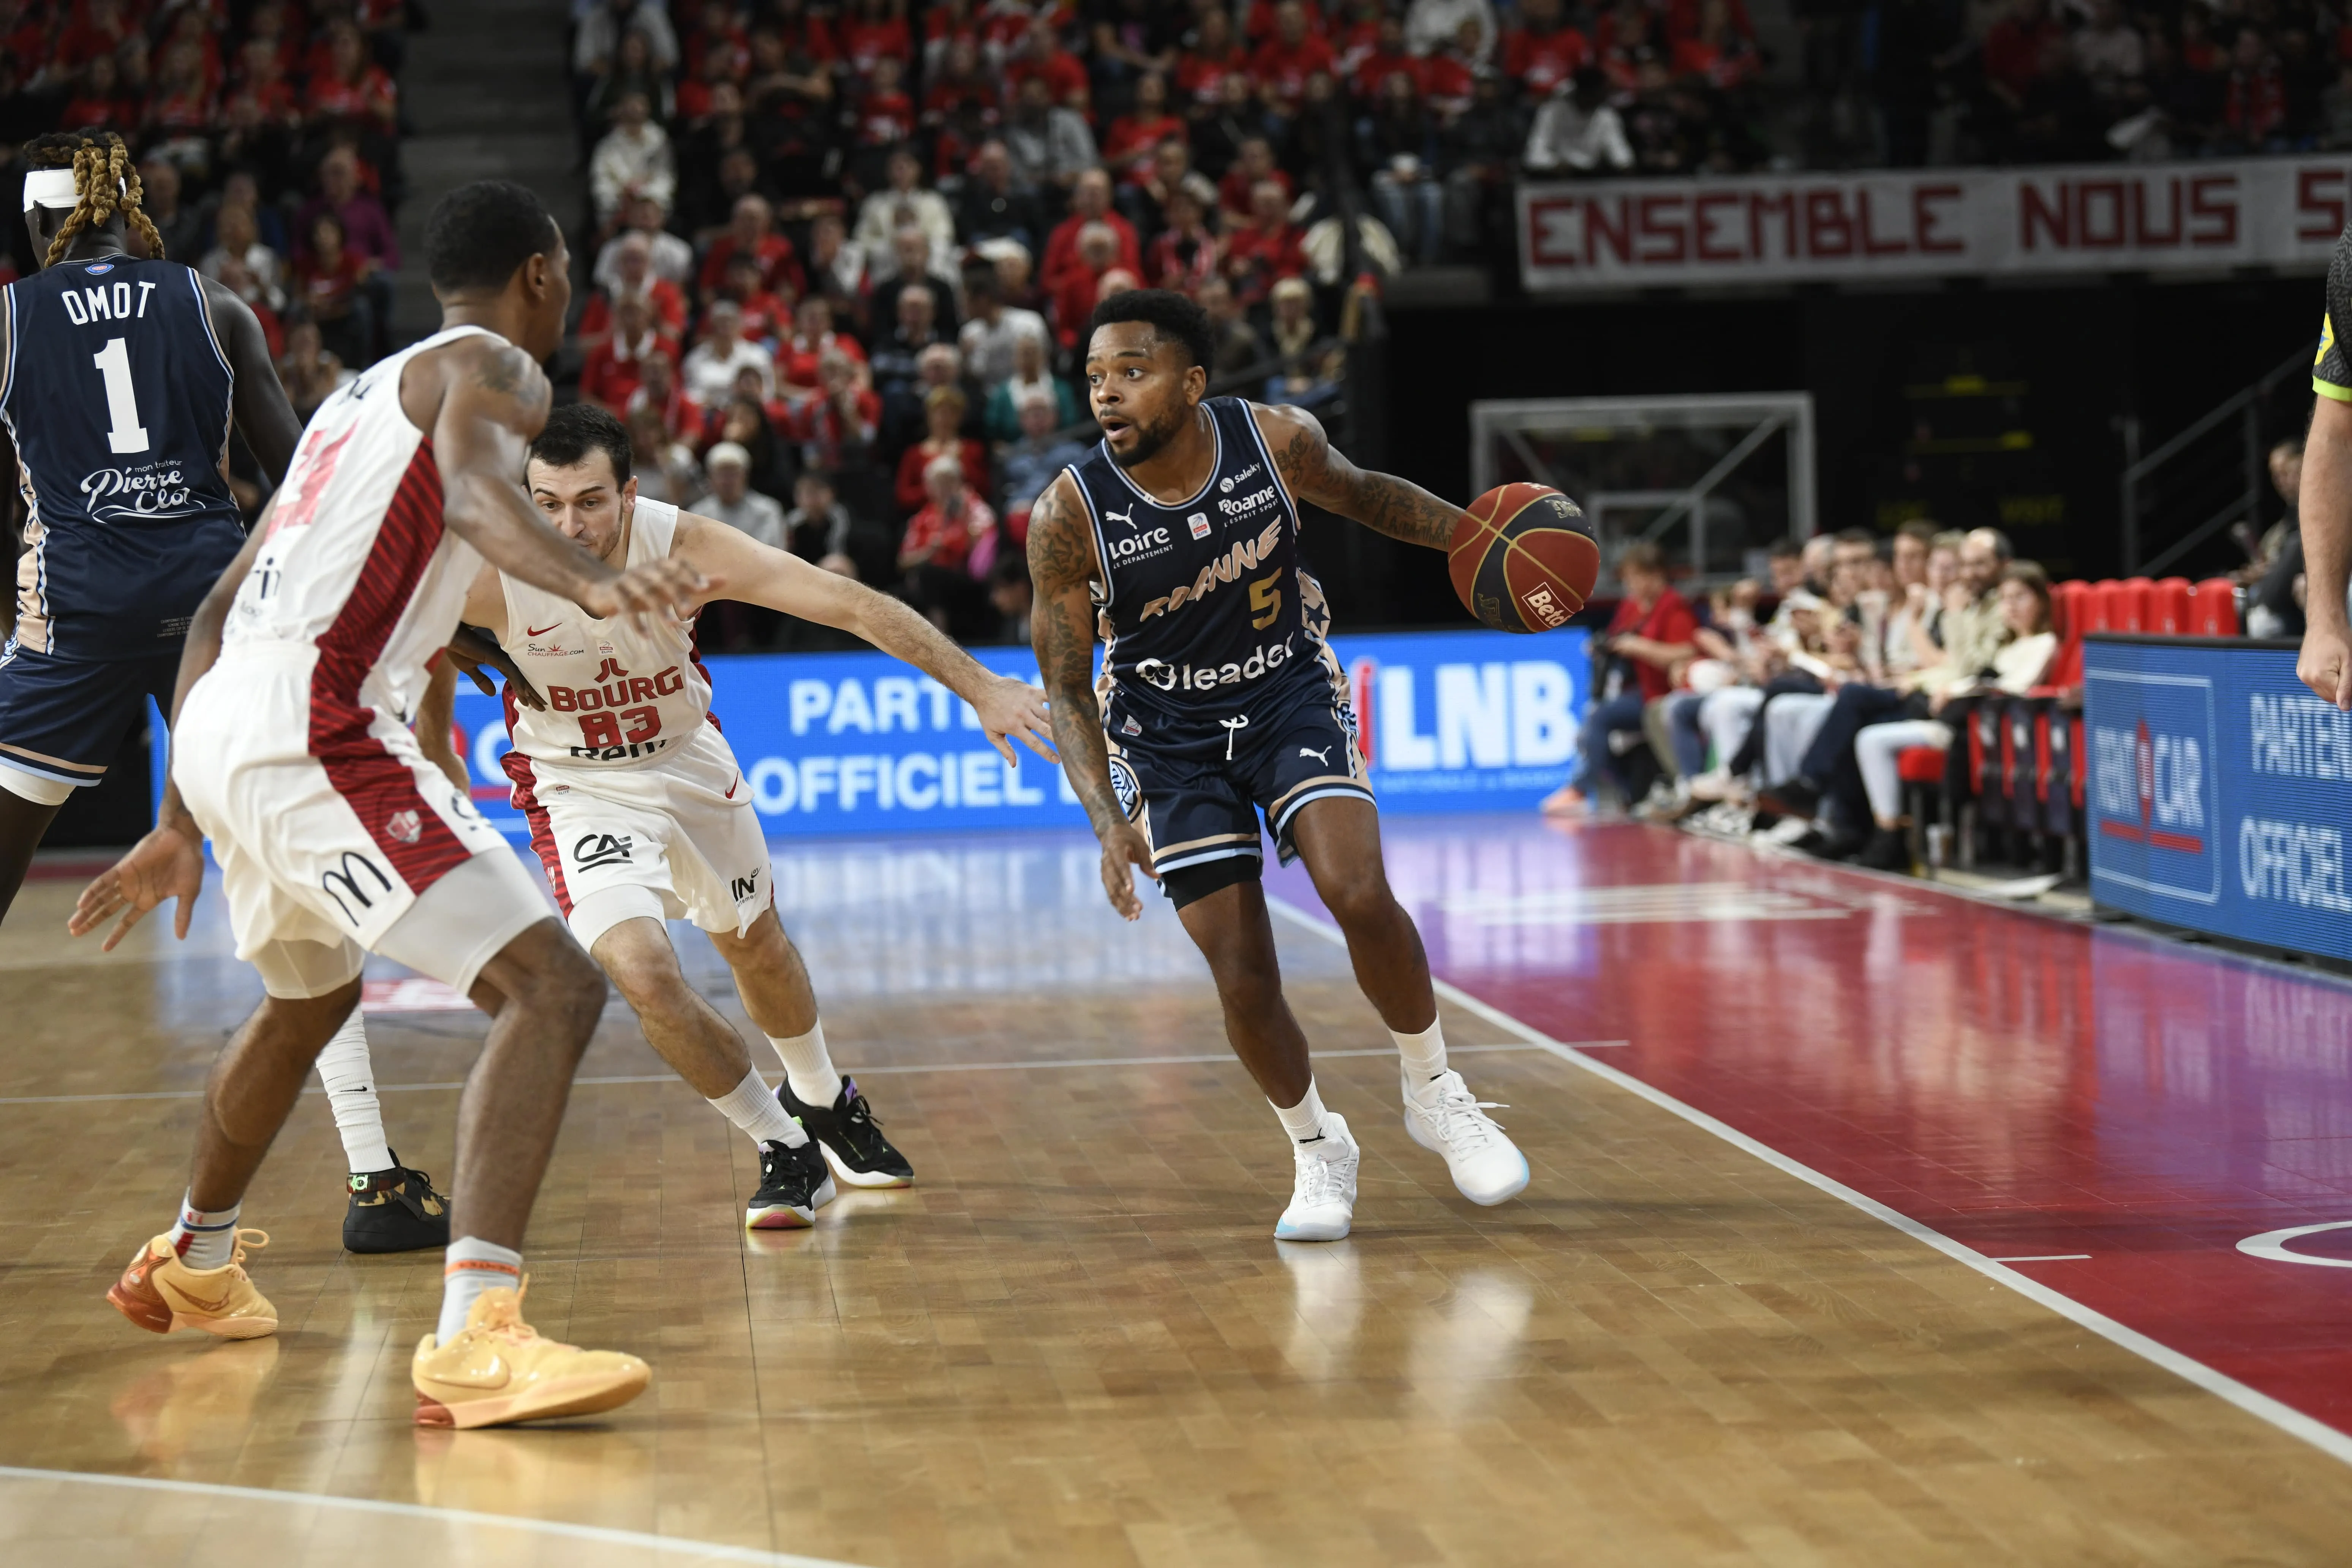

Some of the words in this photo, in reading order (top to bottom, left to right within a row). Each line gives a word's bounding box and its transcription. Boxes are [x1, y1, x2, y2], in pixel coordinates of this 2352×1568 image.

[1529, 185, 1966, 267] ENSEMBLE
[2018, 175, 2237, 251] NOUS
[2296, 169, 2350, 241] S
[62, 281, 156, 325] OMOT
[93, 337, 150, 454] 1
[135, 464, 153, 473] mon
[155, 459, 183, 469] traiteur
[80, 467, 184, 514] Pierre
[1218, 485, 1275, 515] Roanne
[1260, 498, 1279, 513] SPORT
[1108, 526, 1170, 560] Loire
[1122, 544, 1174, 566] DÉPARTEMENT
[1140, 514, 1282, 622] ROANNE
[1249, 566, 1282, 631] 5
[528, 643, 545, 652] Sun
[1182, 631, 1295, 691] leader
[547, 666, 684, 712] BOURG
[577, 705, 662, 748] 83
[1379, 660, 1578, 771] LNB
[748, 749, 1045, 816] OFFICIEL
[731, 877, 755, 902] IN
